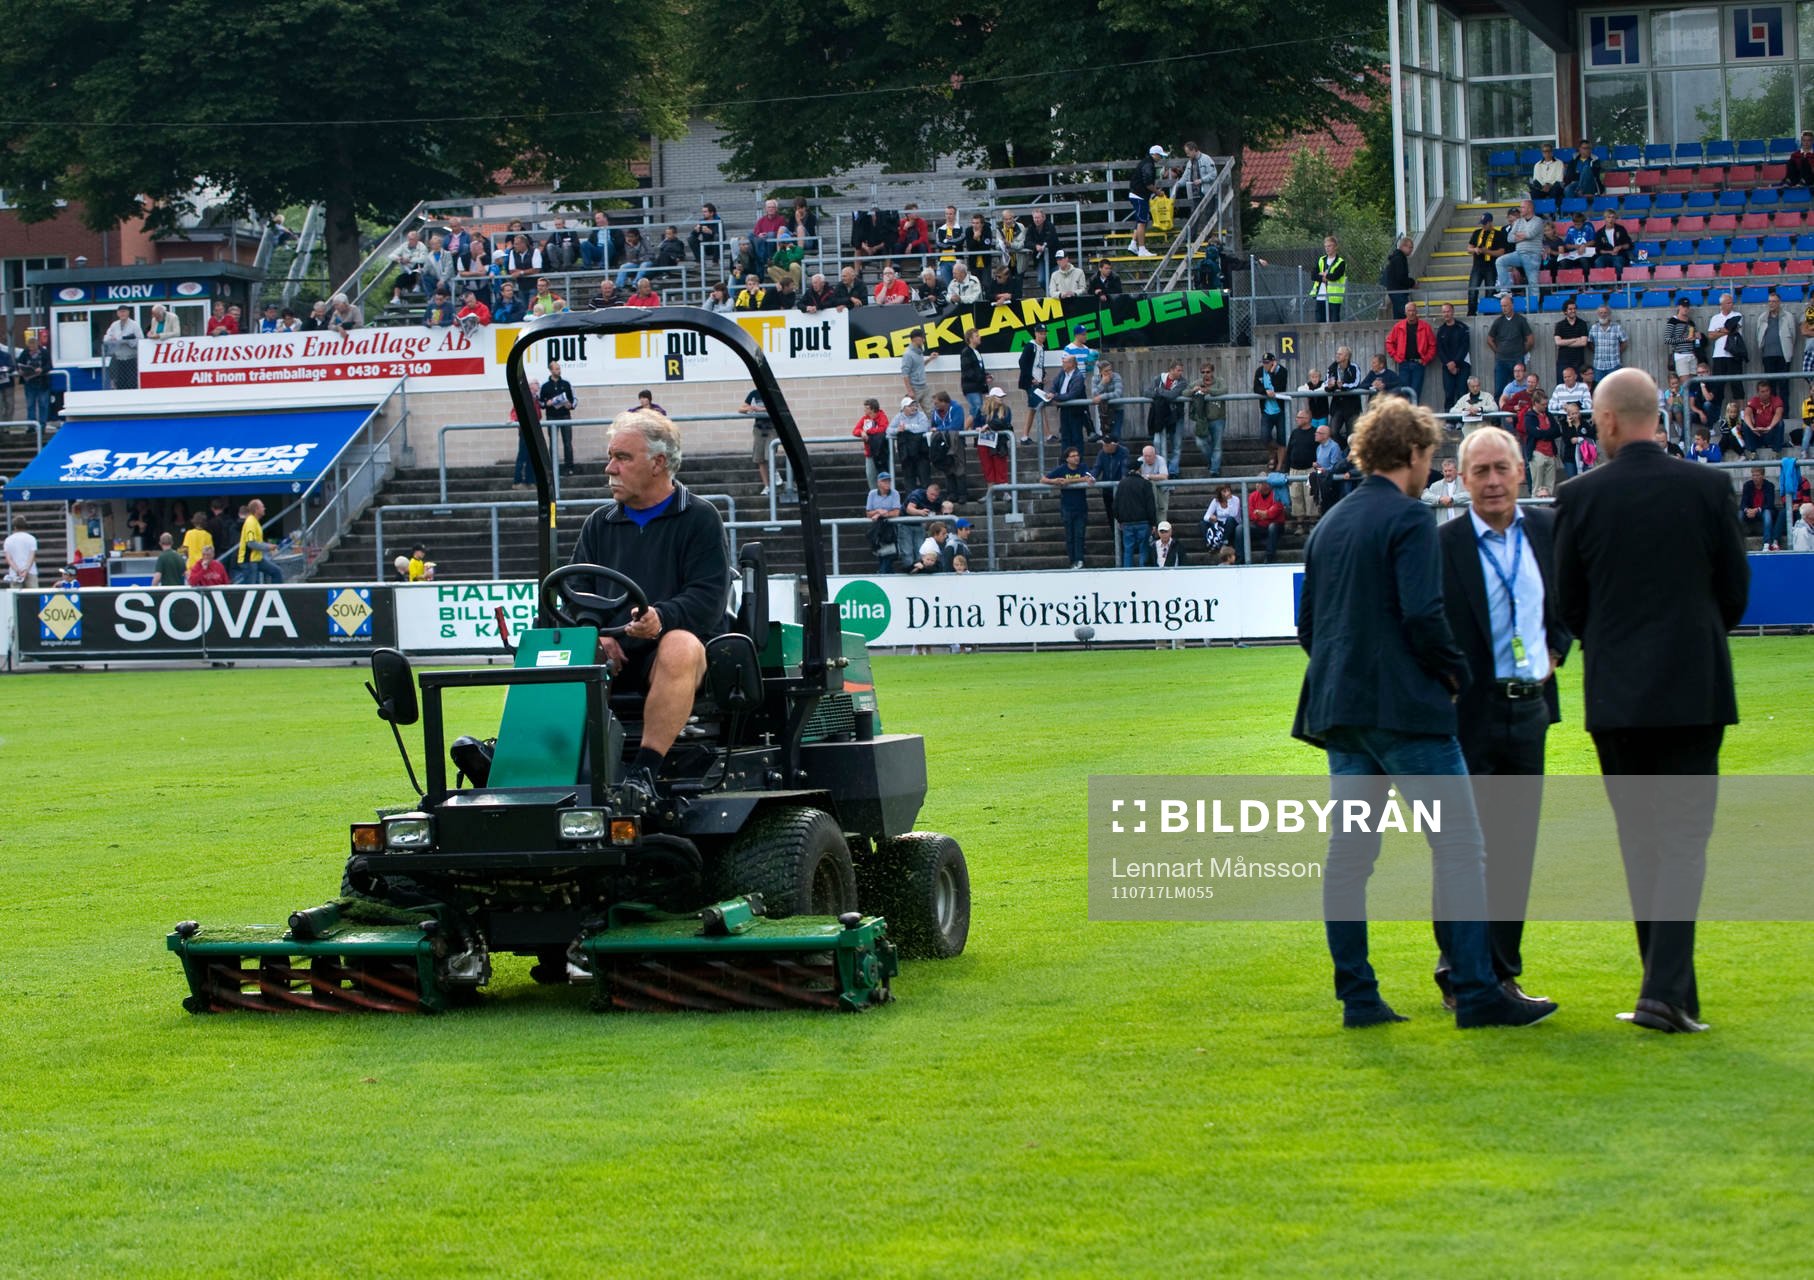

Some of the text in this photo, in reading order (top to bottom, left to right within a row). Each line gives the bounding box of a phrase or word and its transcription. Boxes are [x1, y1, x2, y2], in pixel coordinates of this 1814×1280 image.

[108, 284, 153, 299] KORV
[855, 297, 1064, 360] REKLAM
[1009, 290, 1224, 352] ATELJEN
[152, 341, 294, 364] Håkanssons
[302, 332, 431, 360] Emballage
[1281, 337, 1295, 353] R
[191, 371, 213, 384] Allt
[215, 371, 246, 383] inom
[249, 367, 328, 382] träemballage
[668, 359, 681, 376] R
[113, 443, 318, 467] TVÅÅKERS
[108, 459, 305, 480] MARKISEN
[44, 609, 77, 621] SOVA
[115, 590, 298, 641] SOVA
[333, 604, 367, 617] SOVA
[840, 600, 885, 619] dina
[906, 591, 1218, 631] Dina Försäkringar
[440, 624, 457, 638] &
